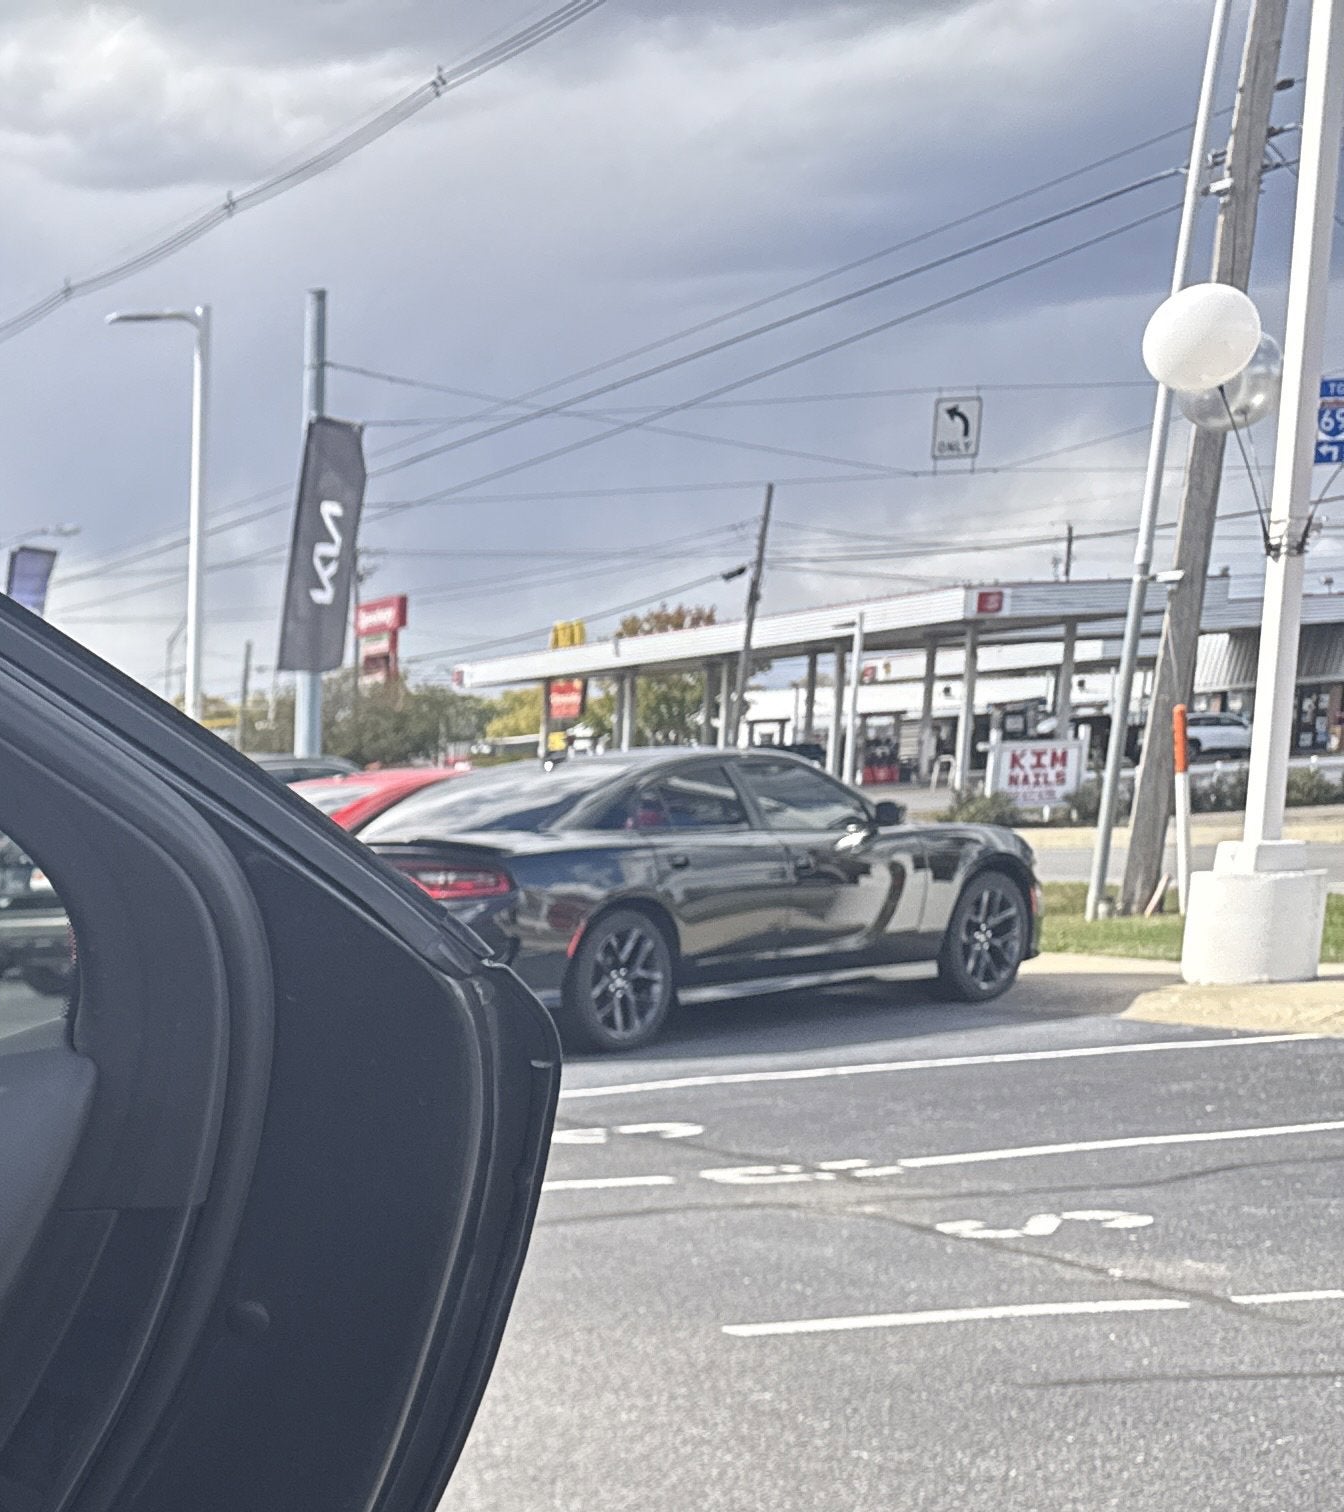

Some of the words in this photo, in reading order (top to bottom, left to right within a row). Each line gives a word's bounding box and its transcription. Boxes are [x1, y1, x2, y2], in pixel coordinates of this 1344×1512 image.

[937, 440, 973, 453] ONLY
[1010, 748, 1067, 769] KIM
[1007, 770, 1066, 787] NAILS
